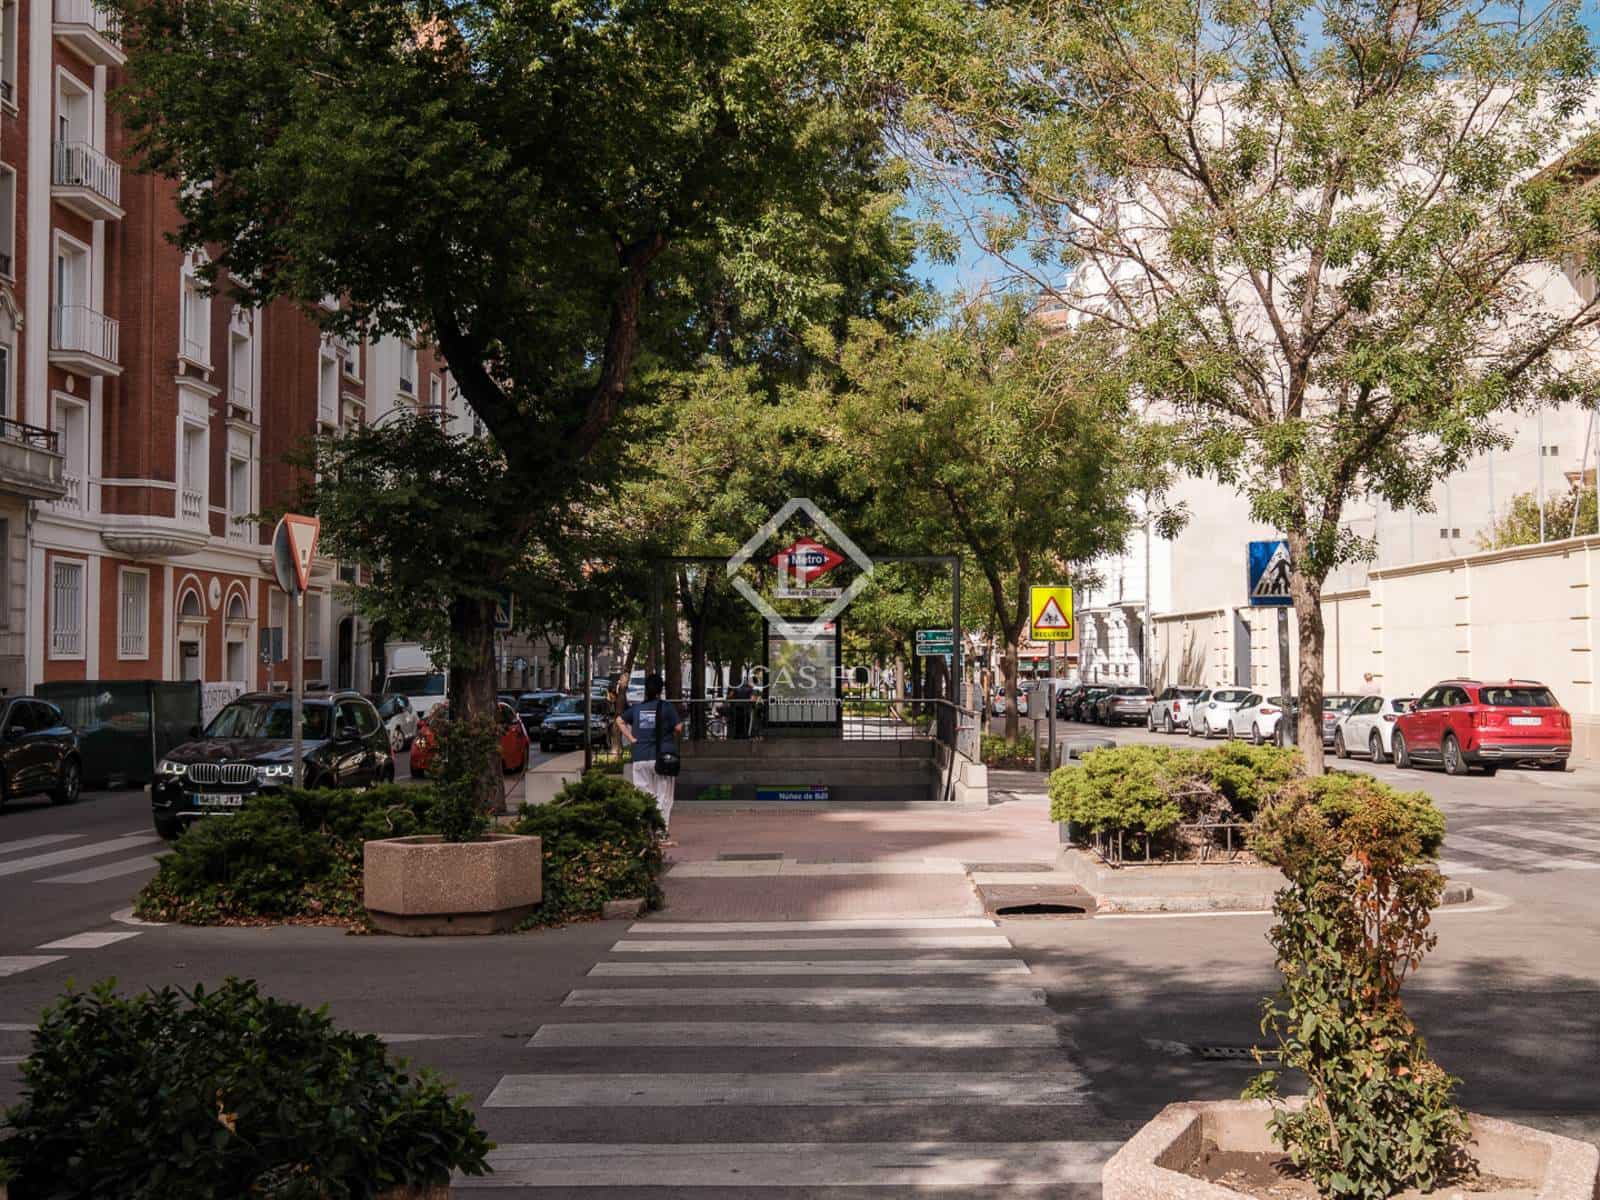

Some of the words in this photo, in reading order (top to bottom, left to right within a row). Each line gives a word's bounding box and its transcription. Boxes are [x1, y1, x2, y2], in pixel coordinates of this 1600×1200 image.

[791, 554, 823, 565] Metro
[779, 791, 802, 800] Núñez
[803, 792, 813, 800] de
